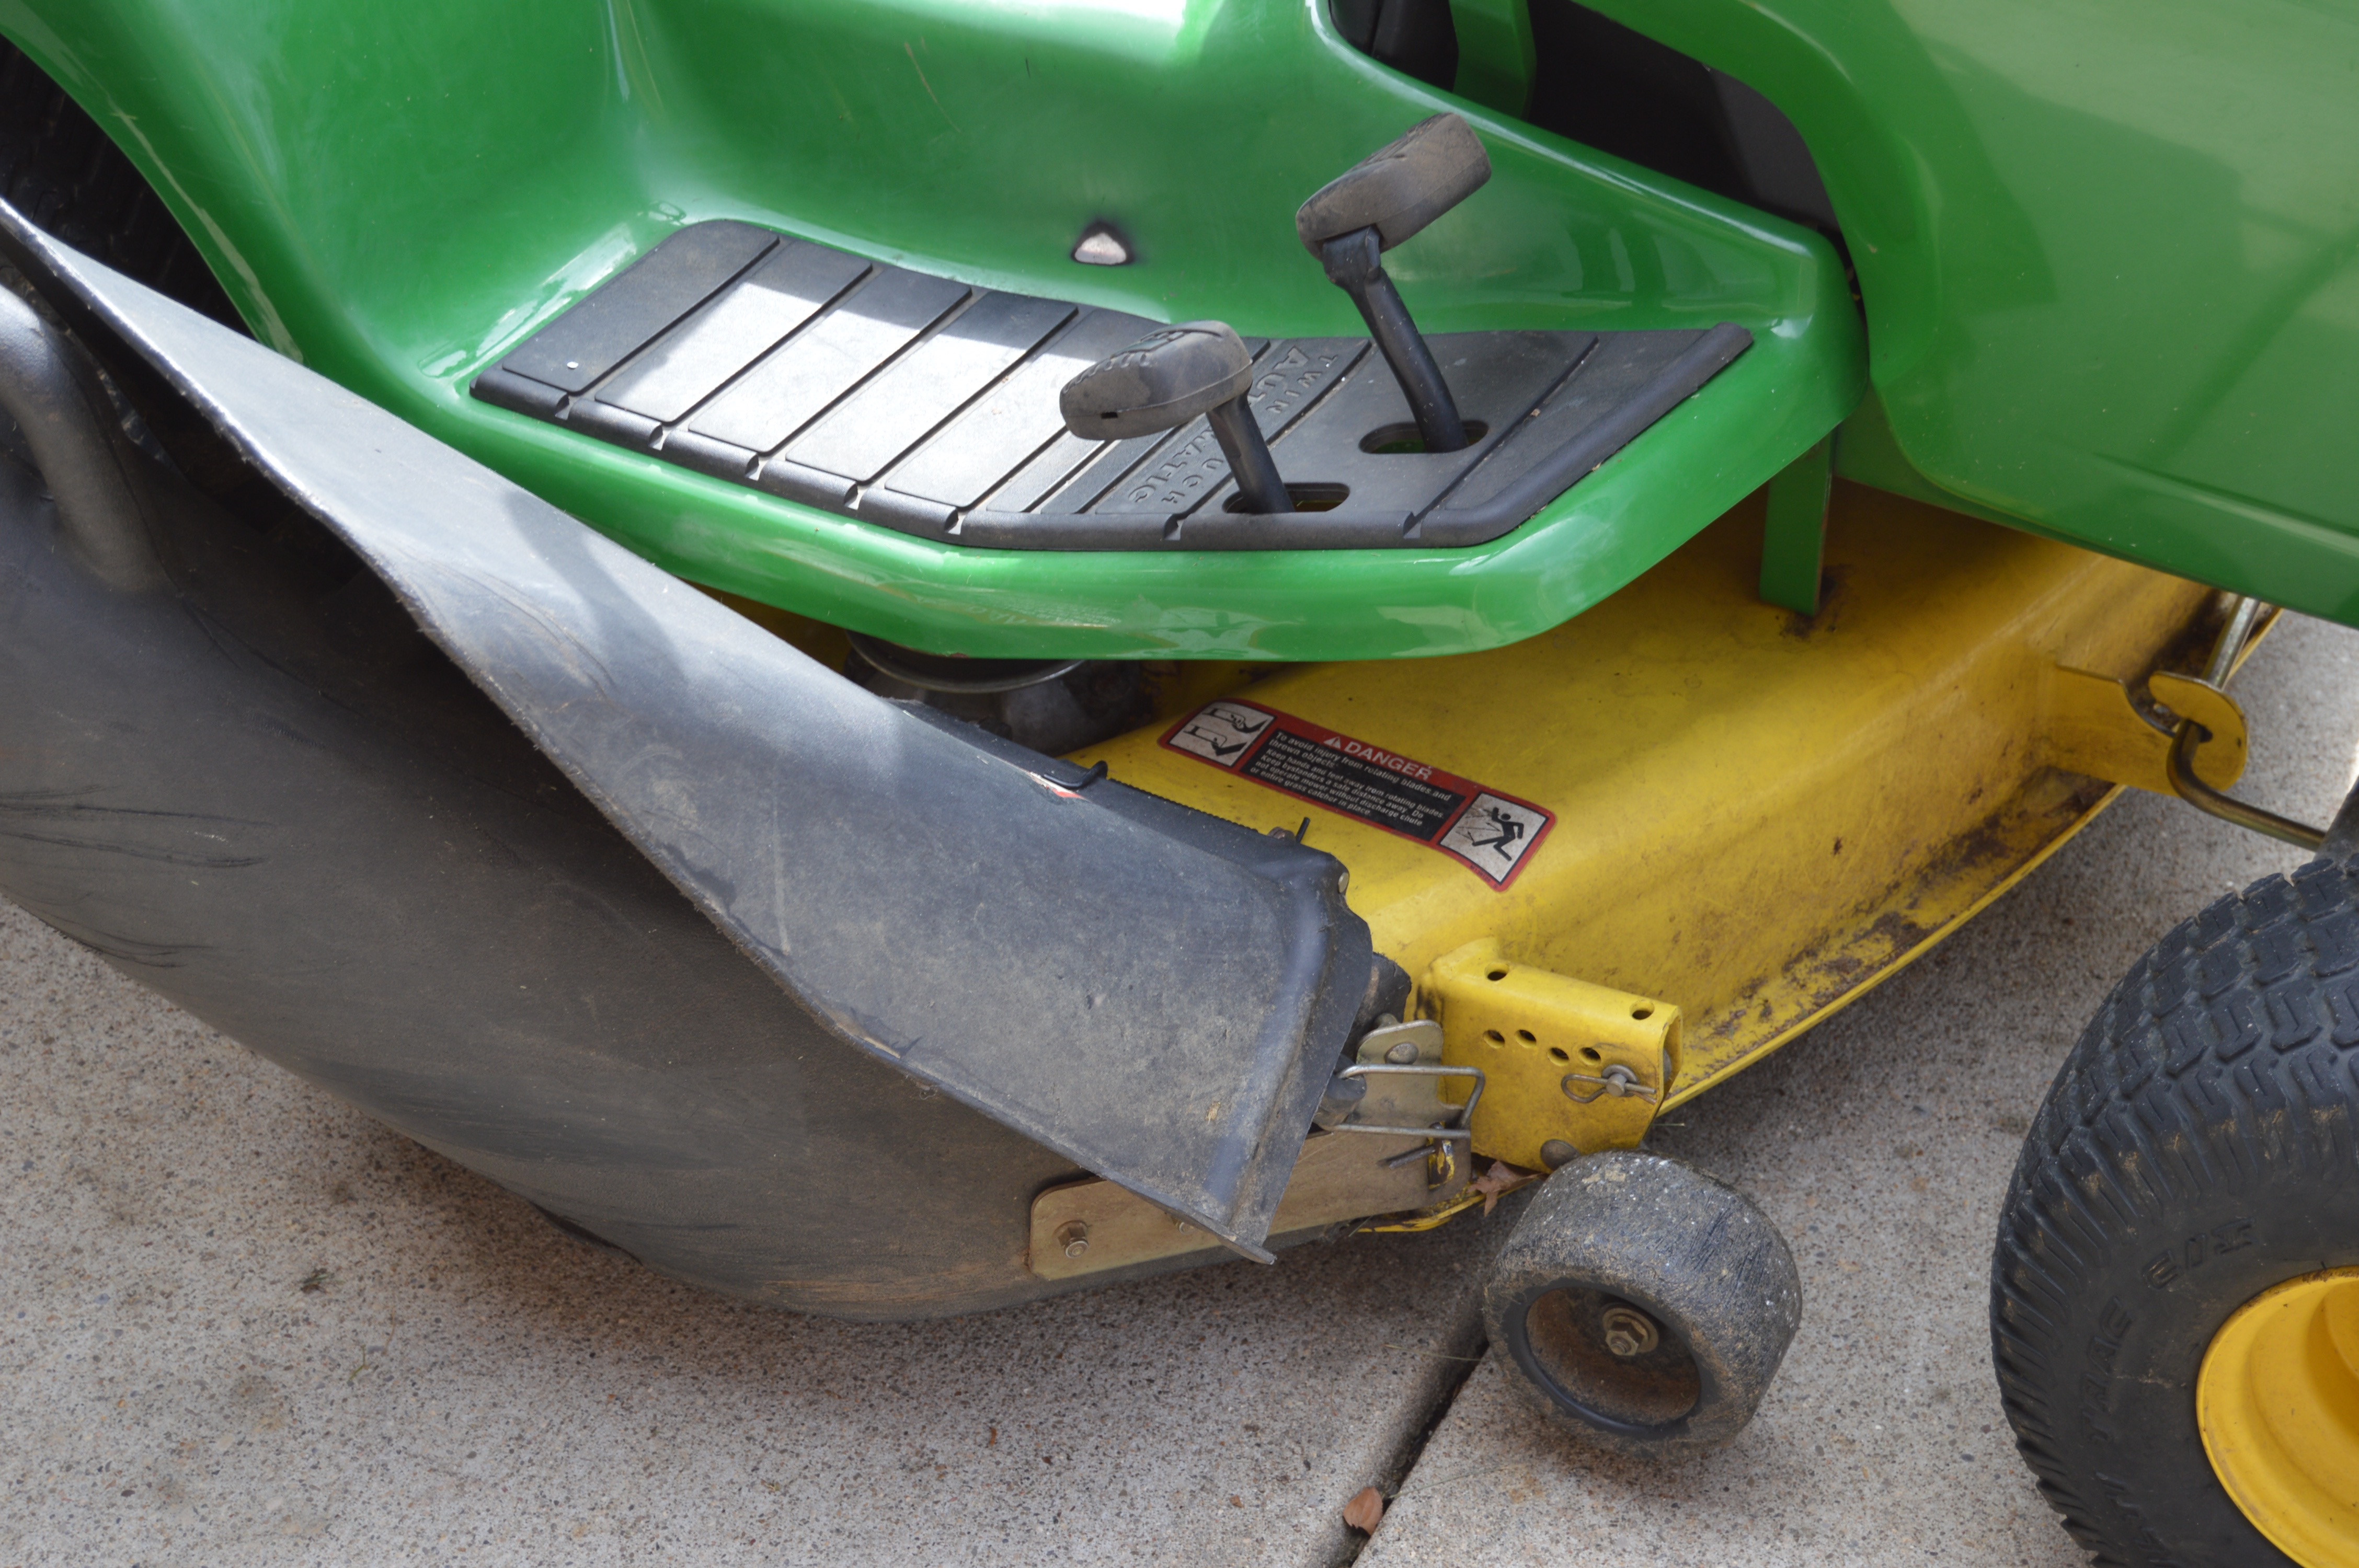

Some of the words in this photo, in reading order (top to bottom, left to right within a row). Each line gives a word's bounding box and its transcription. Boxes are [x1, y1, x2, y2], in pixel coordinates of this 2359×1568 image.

[1266, 354, 1339, 414] TWIN
[1128, 345, 1310, 503] AUTMATIC
[1269, 739, 1300, 755] thrown
[1276, 732, 1287, 741] To
[1288, 739, 1314, 751] avoid
[1311, 747, 1341, 762] injury
[1341, 757, 1363, 769] from
[1364, 766, 1400, 783] rotating
[1401, 779, 1431, 794] blades
[1432, 791, 1451, 801] and
[1344, 741, 1433, 780] DANGER
[1261, 755, 1281, 766] Keep
[1282, 763, 1325, 782] bystanders
[1333, 782, 1350, 792] safe
[1351, 789, 1385, 804] distance
[1412, 810, 1424, 818] Do
[1261, 771, 1284, 783] entire
[1284, 780, 1307, 791] grass
[1308, 789, 1337, 802] catcher
[1264, 748, 1286, 760] Keep
[1287, 756, 1310, 769] hands
[1311, 767, 1327, 775] and
[1327, 771, 1344, 781] feet
[1344, 779, 1365, 790] away
[1365, 786, 1384, 796] from
[1385, 793, 1416, 809] rotating
[1269, 767, 1300, 781] operate
[1301, 778, 1328, 791] mower
[1330, 789, 1359, 803] without
[1359, 800, 1399, 817] discharge
[1400, 815, 1422, 826] chute
